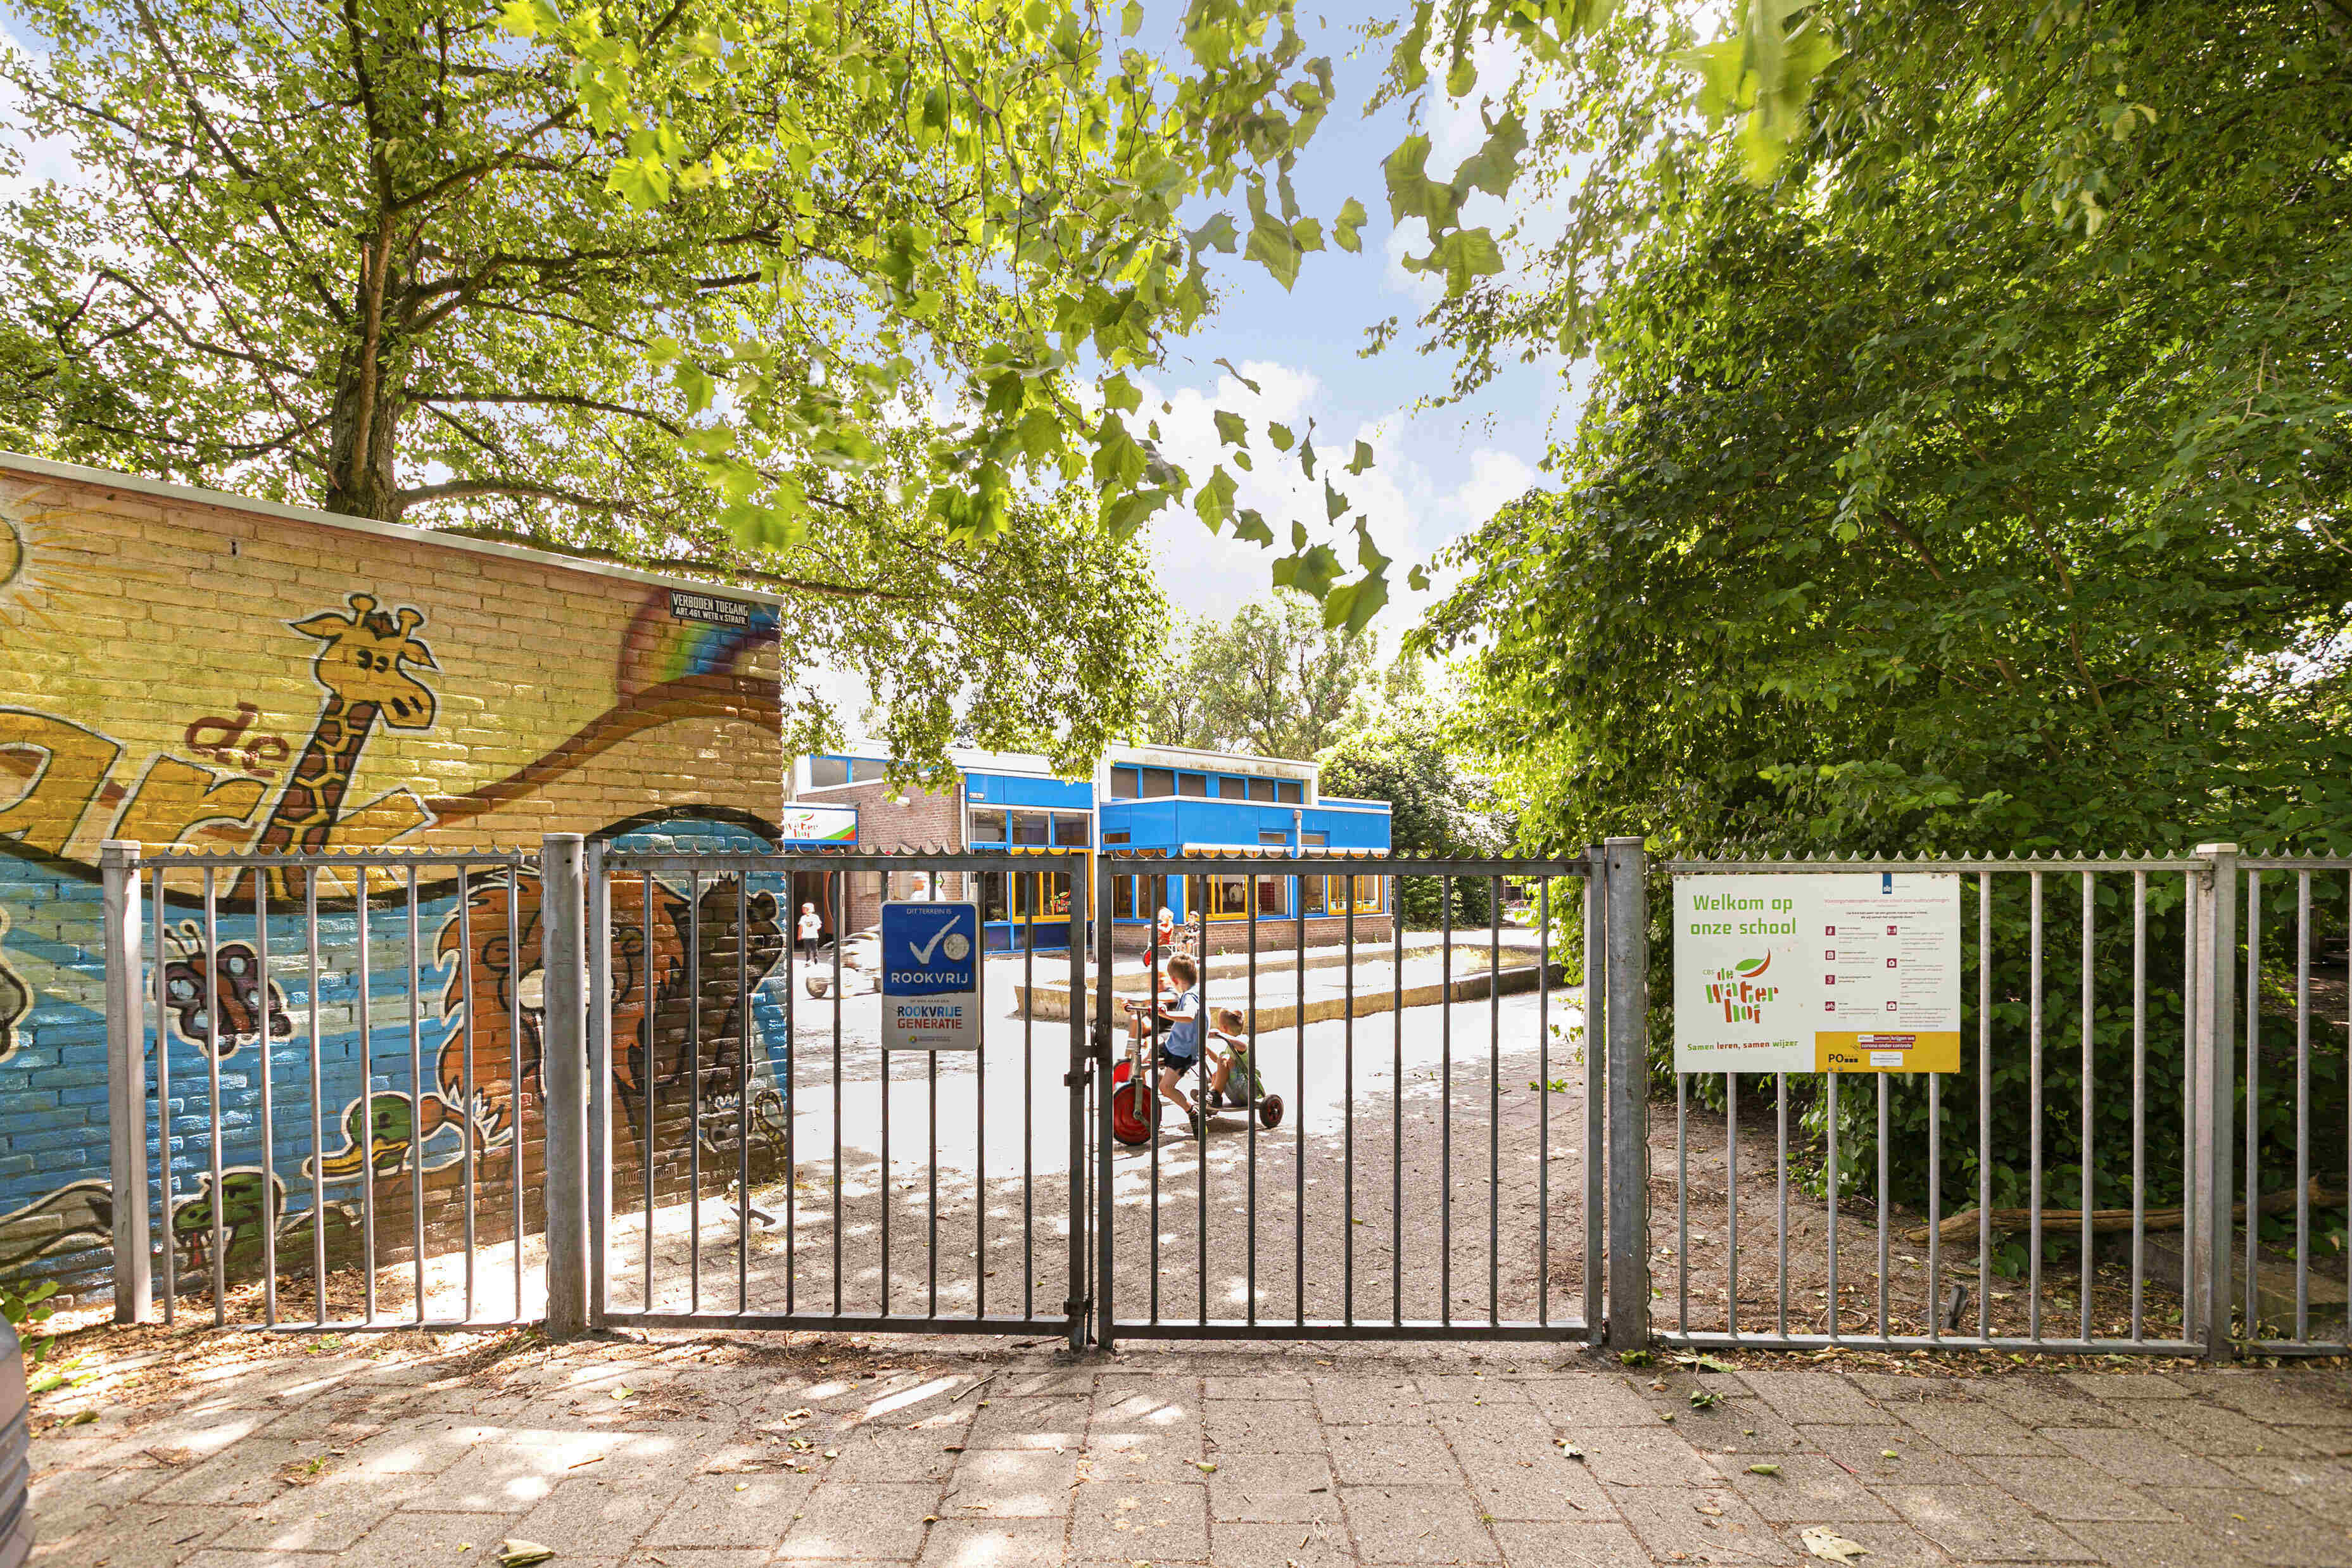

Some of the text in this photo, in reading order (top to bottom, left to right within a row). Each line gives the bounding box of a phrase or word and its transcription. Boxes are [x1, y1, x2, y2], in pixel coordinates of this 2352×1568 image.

[673, 593, 749, 616] VERBODEN TOEGANG
[724, 614, 748, 625] STRAFR.
[1693, 894, 1793, 914] Welkom op
[1690, 917, 1797, 935] onze school
[891, 973, 968, 983] ROOKVRIJ
[1717, 967, 1733, 981] de
[897, 1006, 963, 1017] ROOKVRIJE
[897, 1018, 963, 1029] GENERATIE
[1687, 1043, 1714, 1051] Samen
[1717, 1042, 1741, 1051] leren,
[1773, 1039, 1799, 1049] wijzer
